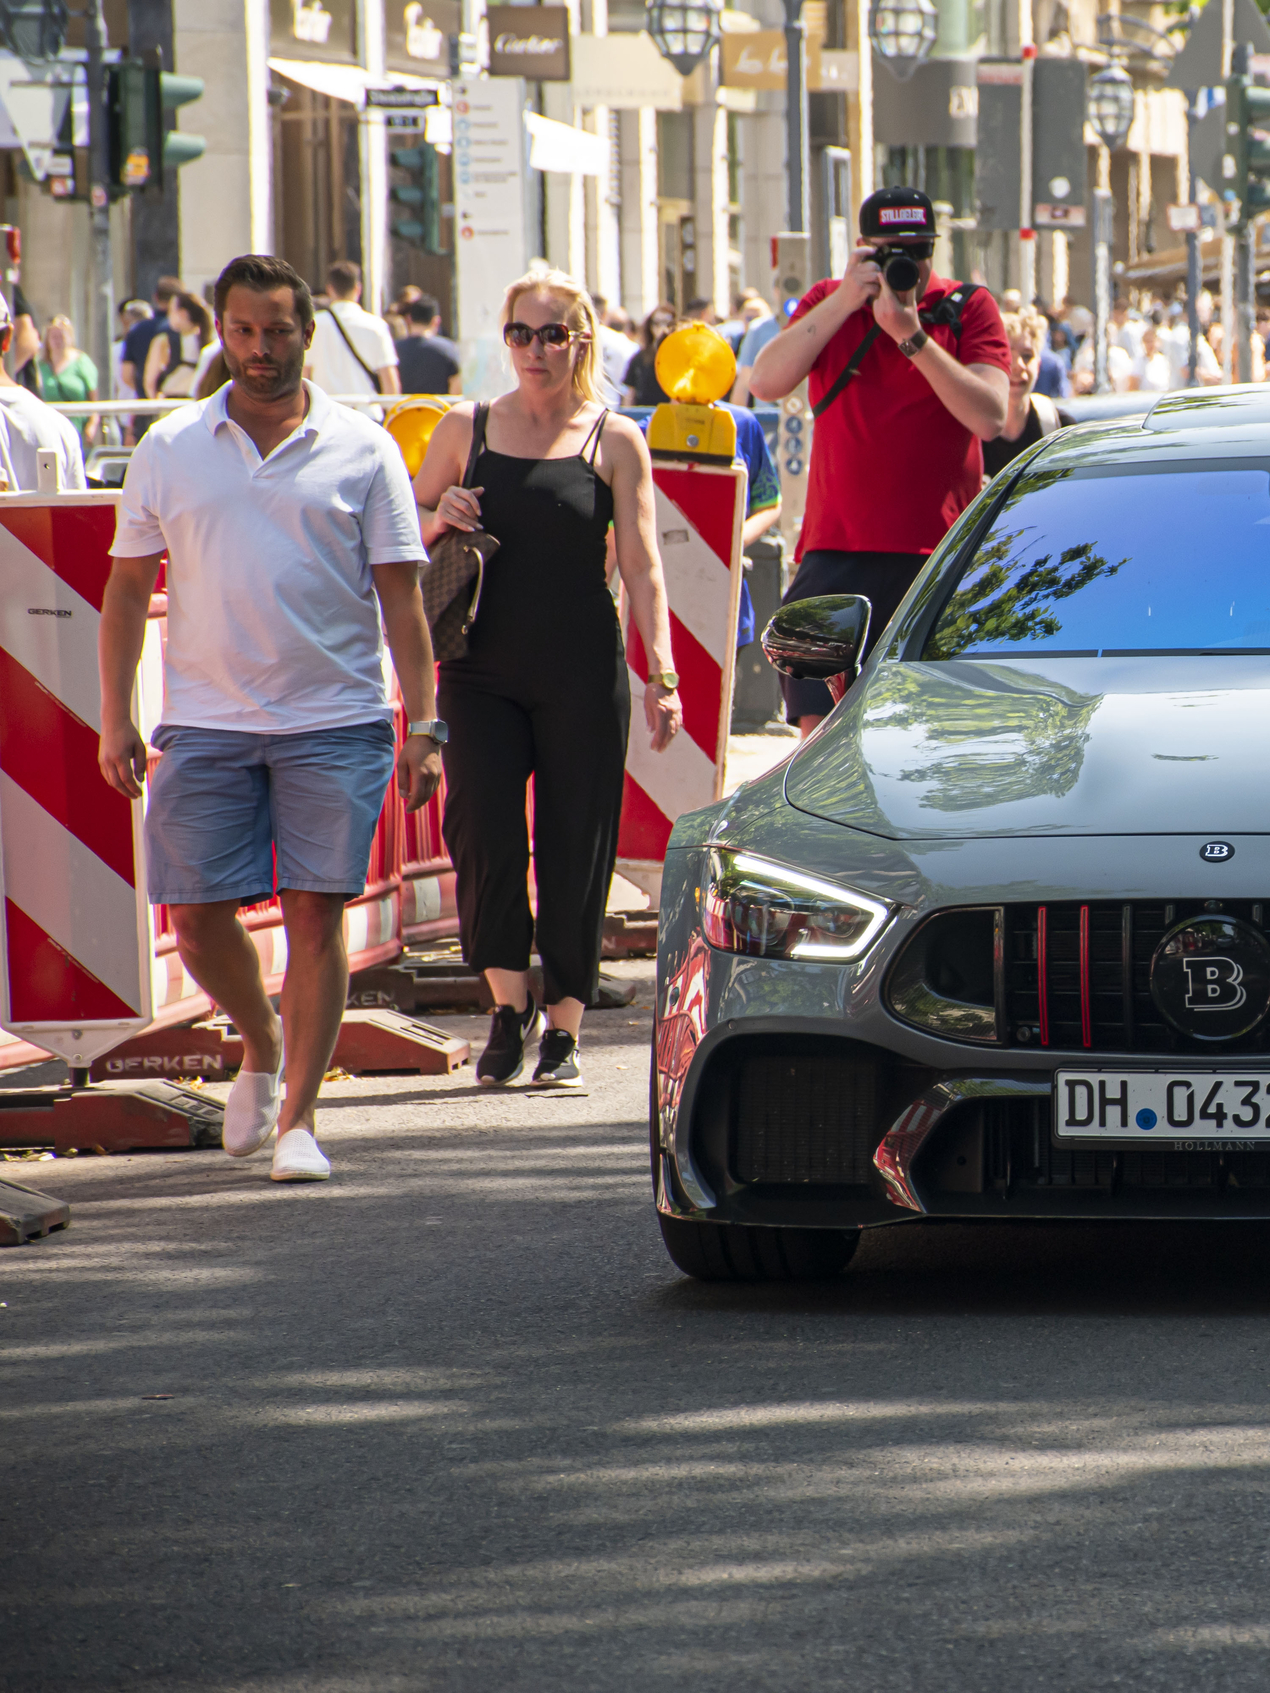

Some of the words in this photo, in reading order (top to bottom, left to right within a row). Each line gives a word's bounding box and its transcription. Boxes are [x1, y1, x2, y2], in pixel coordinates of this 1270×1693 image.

[27, 608, 72, 617] GERKEN
[1183, 956, 1247, 1011] B
[1064, 1078, 1129, 1128] DH
[1174, 1141, 1256, 1150] HOLLMANN
